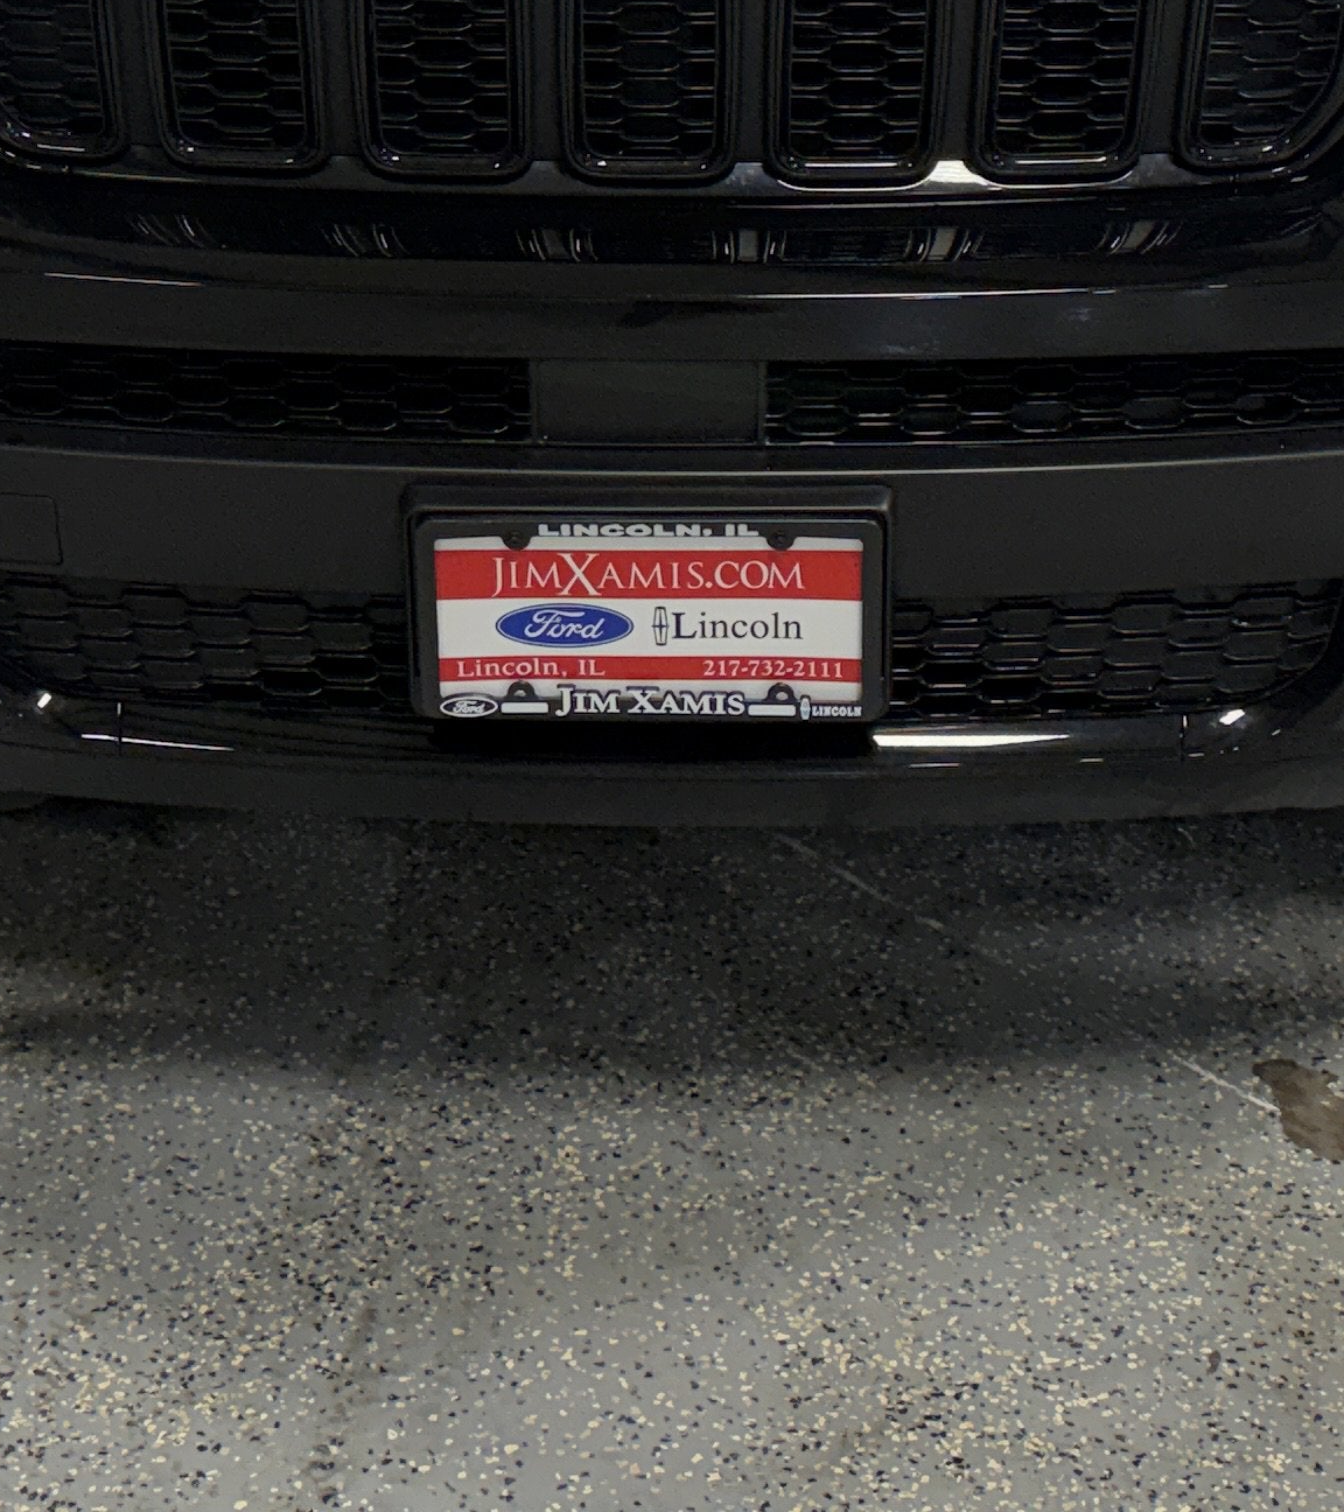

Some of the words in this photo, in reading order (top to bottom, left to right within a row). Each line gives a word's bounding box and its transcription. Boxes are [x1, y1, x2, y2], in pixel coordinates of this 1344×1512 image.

[724, 523, 760, 537] IL
[523, 608, 605, 641] Ford
[671, 611, 803, 640] Lincoln
[456, 658, 568, 678] Lincoln,
[578, 659, 606, 676] IL
[702, 659, 844, 679] 217-732-2111
[453, 700, 486, 715] Ford
[555, 686, 621, 717] JIM
[627, 688, 746, 716] XAMIS
[811, 705, 862, 717] LINCOLN
